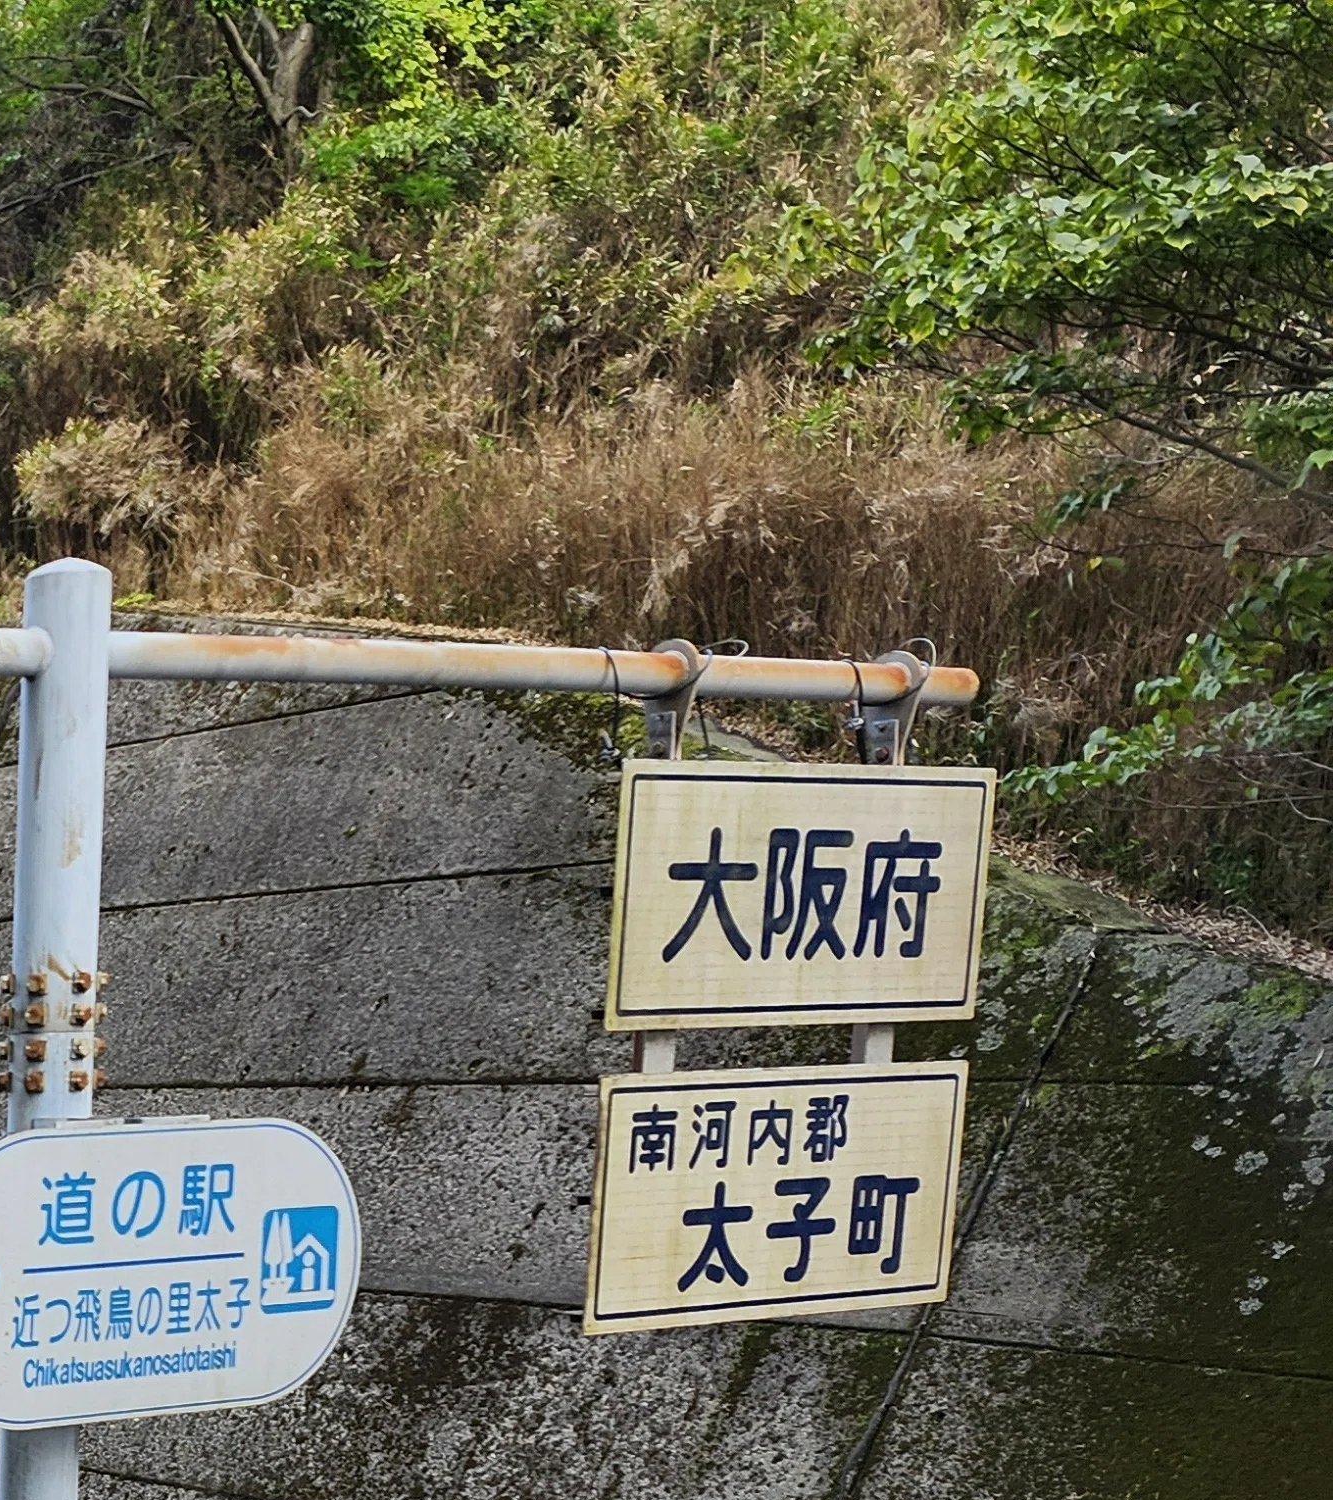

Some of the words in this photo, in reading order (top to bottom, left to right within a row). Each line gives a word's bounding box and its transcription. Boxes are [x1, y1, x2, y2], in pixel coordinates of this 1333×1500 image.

[662, 827, 941, 963] 大阪府
[629, 1095, 849, 1173] 南河内郡
[38, 1163, 235, 1246] 道の駅
[677, 1175, 920, 1292] 太子町
[12, 1278, 251, 1349] 近つ飛鳥の里太子
[23, 1341, 237, 1388] Chikatsuasukanosatotaishi
